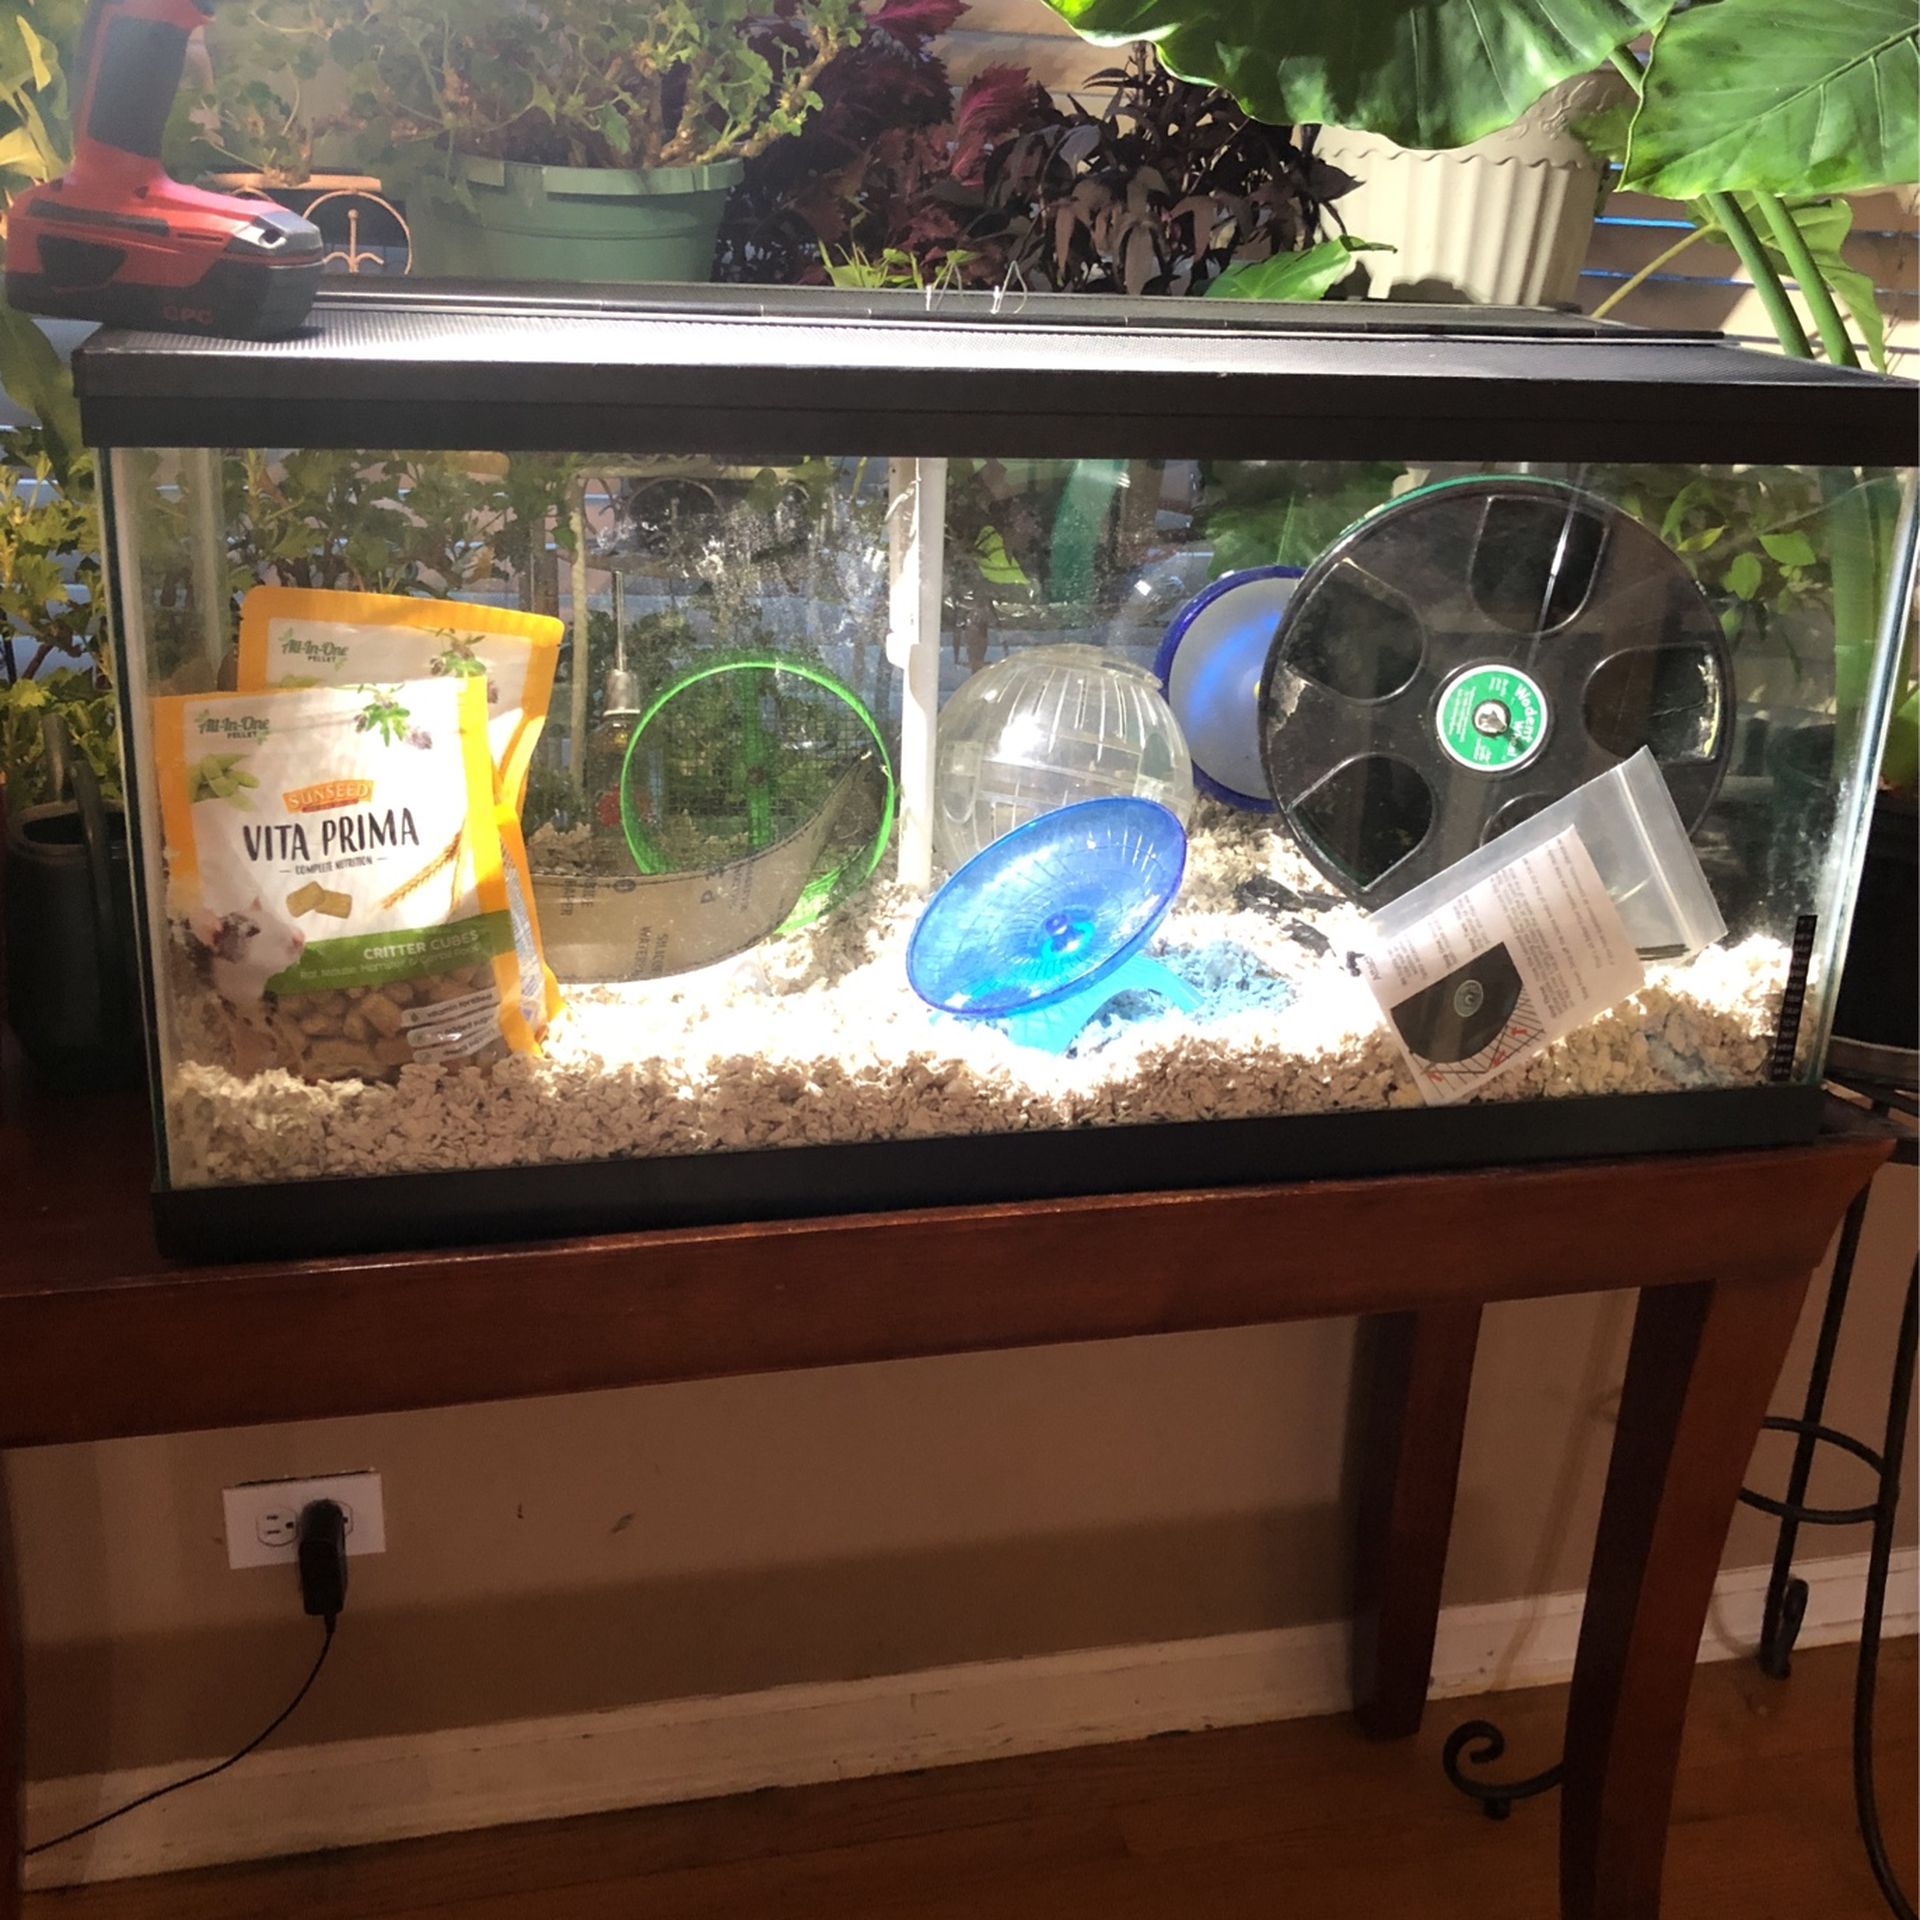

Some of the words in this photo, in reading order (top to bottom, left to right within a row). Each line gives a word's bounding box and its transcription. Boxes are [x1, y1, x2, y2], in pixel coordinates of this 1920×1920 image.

[281, 639, 349, 656] All-In-One
[307, 655, 337, 663] PELLET
[1514, 683, 1539, 743] Wodent
[198, 715, 270, 735] All-In-One
[227, 731, 257, 739] PELLET
[288, 782, 369, 808] SUNSEED
[242, 823, 311, 861] VITA
[322, 807, 420, 856] PRIMA
[295, 861, 333, 876] COMPLETE
[335, 855, 373, 871] NUTRITION
[363, 942, 426, 960] CRITTER
[430, 929, 480, 951] CUBES
